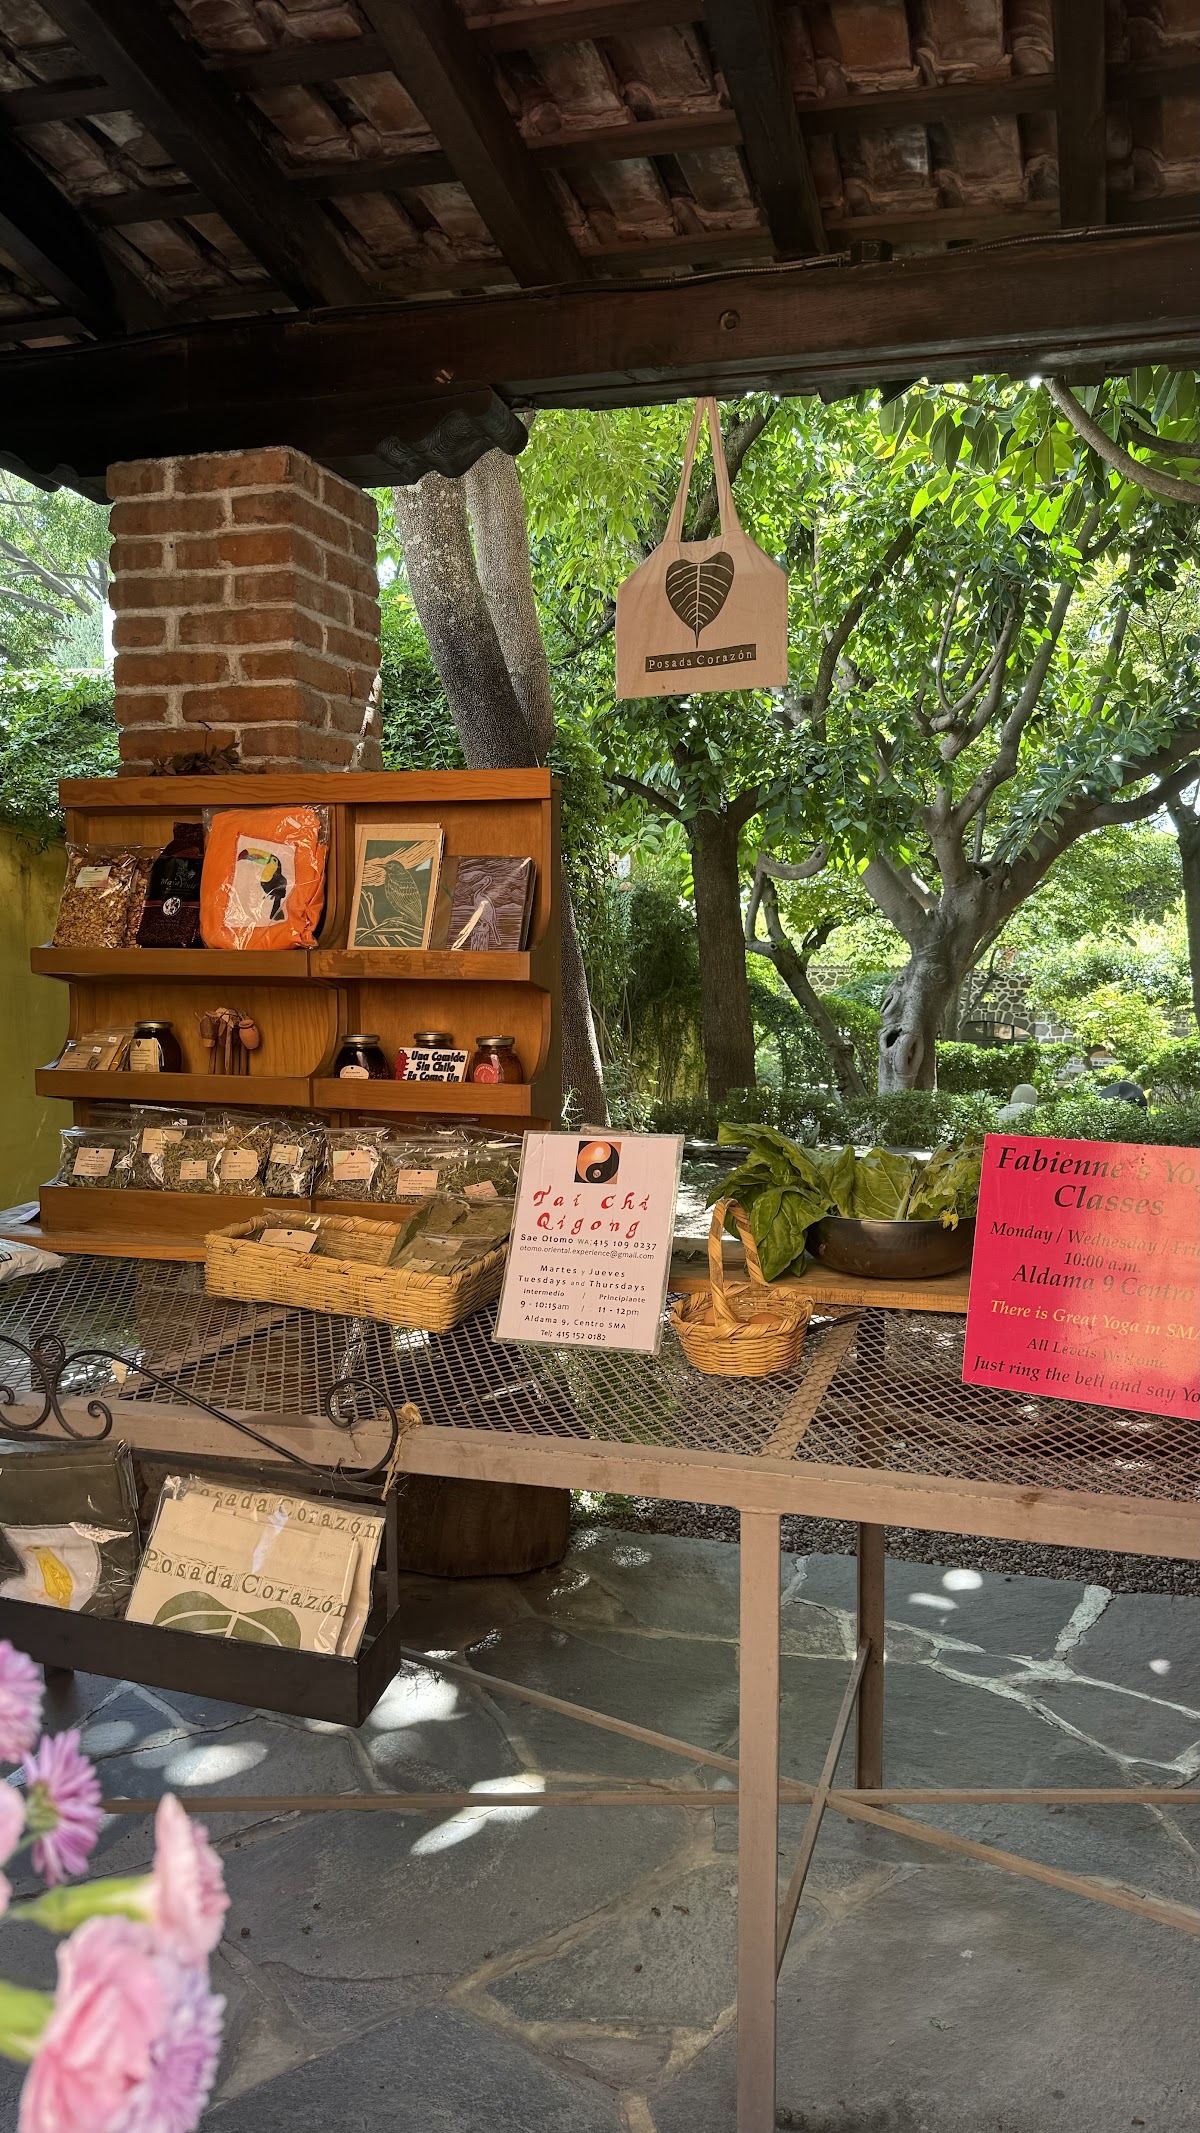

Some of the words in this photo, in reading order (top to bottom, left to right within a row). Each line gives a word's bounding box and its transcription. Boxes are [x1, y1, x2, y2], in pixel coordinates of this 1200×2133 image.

[648, 658, 692, 670] Posada
[696, 649, 752, 665] Corazón
[411, 1051, 429, 1060] Una
[431, 1052, 466, 1062] Comida
[415, 1061, 430, 1071] Sin
[407, 1071, 417, 1080] Es
[419, 1072, 444, 1081] Como
[447, 1073, 460, 1082] Un
[533, 1185, 582, 1207] Tai
[600, 1191, 650, 1211] Chi
[1054, 1184, 1165, 1216] Classes
[536, 1212, 641, 1239] Qigong
[520, 1233, 538, 1241] Sae
[541, 1234, 574, 1244] Otomo
[613, 1240, 629, 1249] 109
[633, 1241, 657, 1251] 0237
[990, 1221, 1053, 1245] Monday
[1056, 1227, 1064, 1244] /
[1068, 1229, 1158, 1256] Wednesday
[1161, 1237, 1169, 1256] /
[519, 1245, 655, 1260] otomo.oriental.experience@gmail.com
[1064, 1252, 1105, 1269] 10:00
[1108, 1260, 1141, 1274] a.m.
[540, 1264, 577, 1274] Martes
[589, 1268, 625, 1278] Jueves
[518, 1274, 566, 1287] Tuesdays
[589, 1280, 645, 1292] Thursdays
[1011, 1264, 1094, 1291] Aldama
[1102, 1274, 1115, 1292] 9
[1120, 1277, 1195, 1303] Centro
[581, 1291, 586, 1300] /
[598, 1293, 646, 1304] Principiante
[520, 1300, 526, 1309] 9
[535, 1301, 570, 1311] 10:15am
[580, 1304, 585, 1313] /
[598, 1306, 606, 1314] 11
[616, 1307, 640, 1317] 12pm
[990, 1299, 1030, 1318] There
[1035, 1306, 1048, 1320] is
[1052, 1308, 1098, 1326] Great
[1103, 1315, 1140, 1336] Yoga
[1145, 1320, 1161, 1335] in
[524, 1314, 558, 1324] Aldama
[573, 1318, 605, 1328] Centro
[608, 1321, 626, 1330] SMA
[556, 1330, 570, 1339] 415
[572, 1331, 585, 1340] 152
[587, 1332, 607, 1341] 0182
[1026, 1338, 1048, 1351] All
[1052, 1341, 1097, 1359] Levels
[973, 1355, 1006, 1373] Just
[1008, 1361, 1041, 1382] ring
[1045, 1367, 1070, 1383] the
[1074, 1371, 1105, 1389] bell
[1110, 1380, 1142, 1394] and
[1146, 1386, 1176, 1403] say
[279, 1498, 378, 1538] Corazón
[143, 1548, 233, 1589] Posada
[241, 1574, 348, 1618] Corazón
